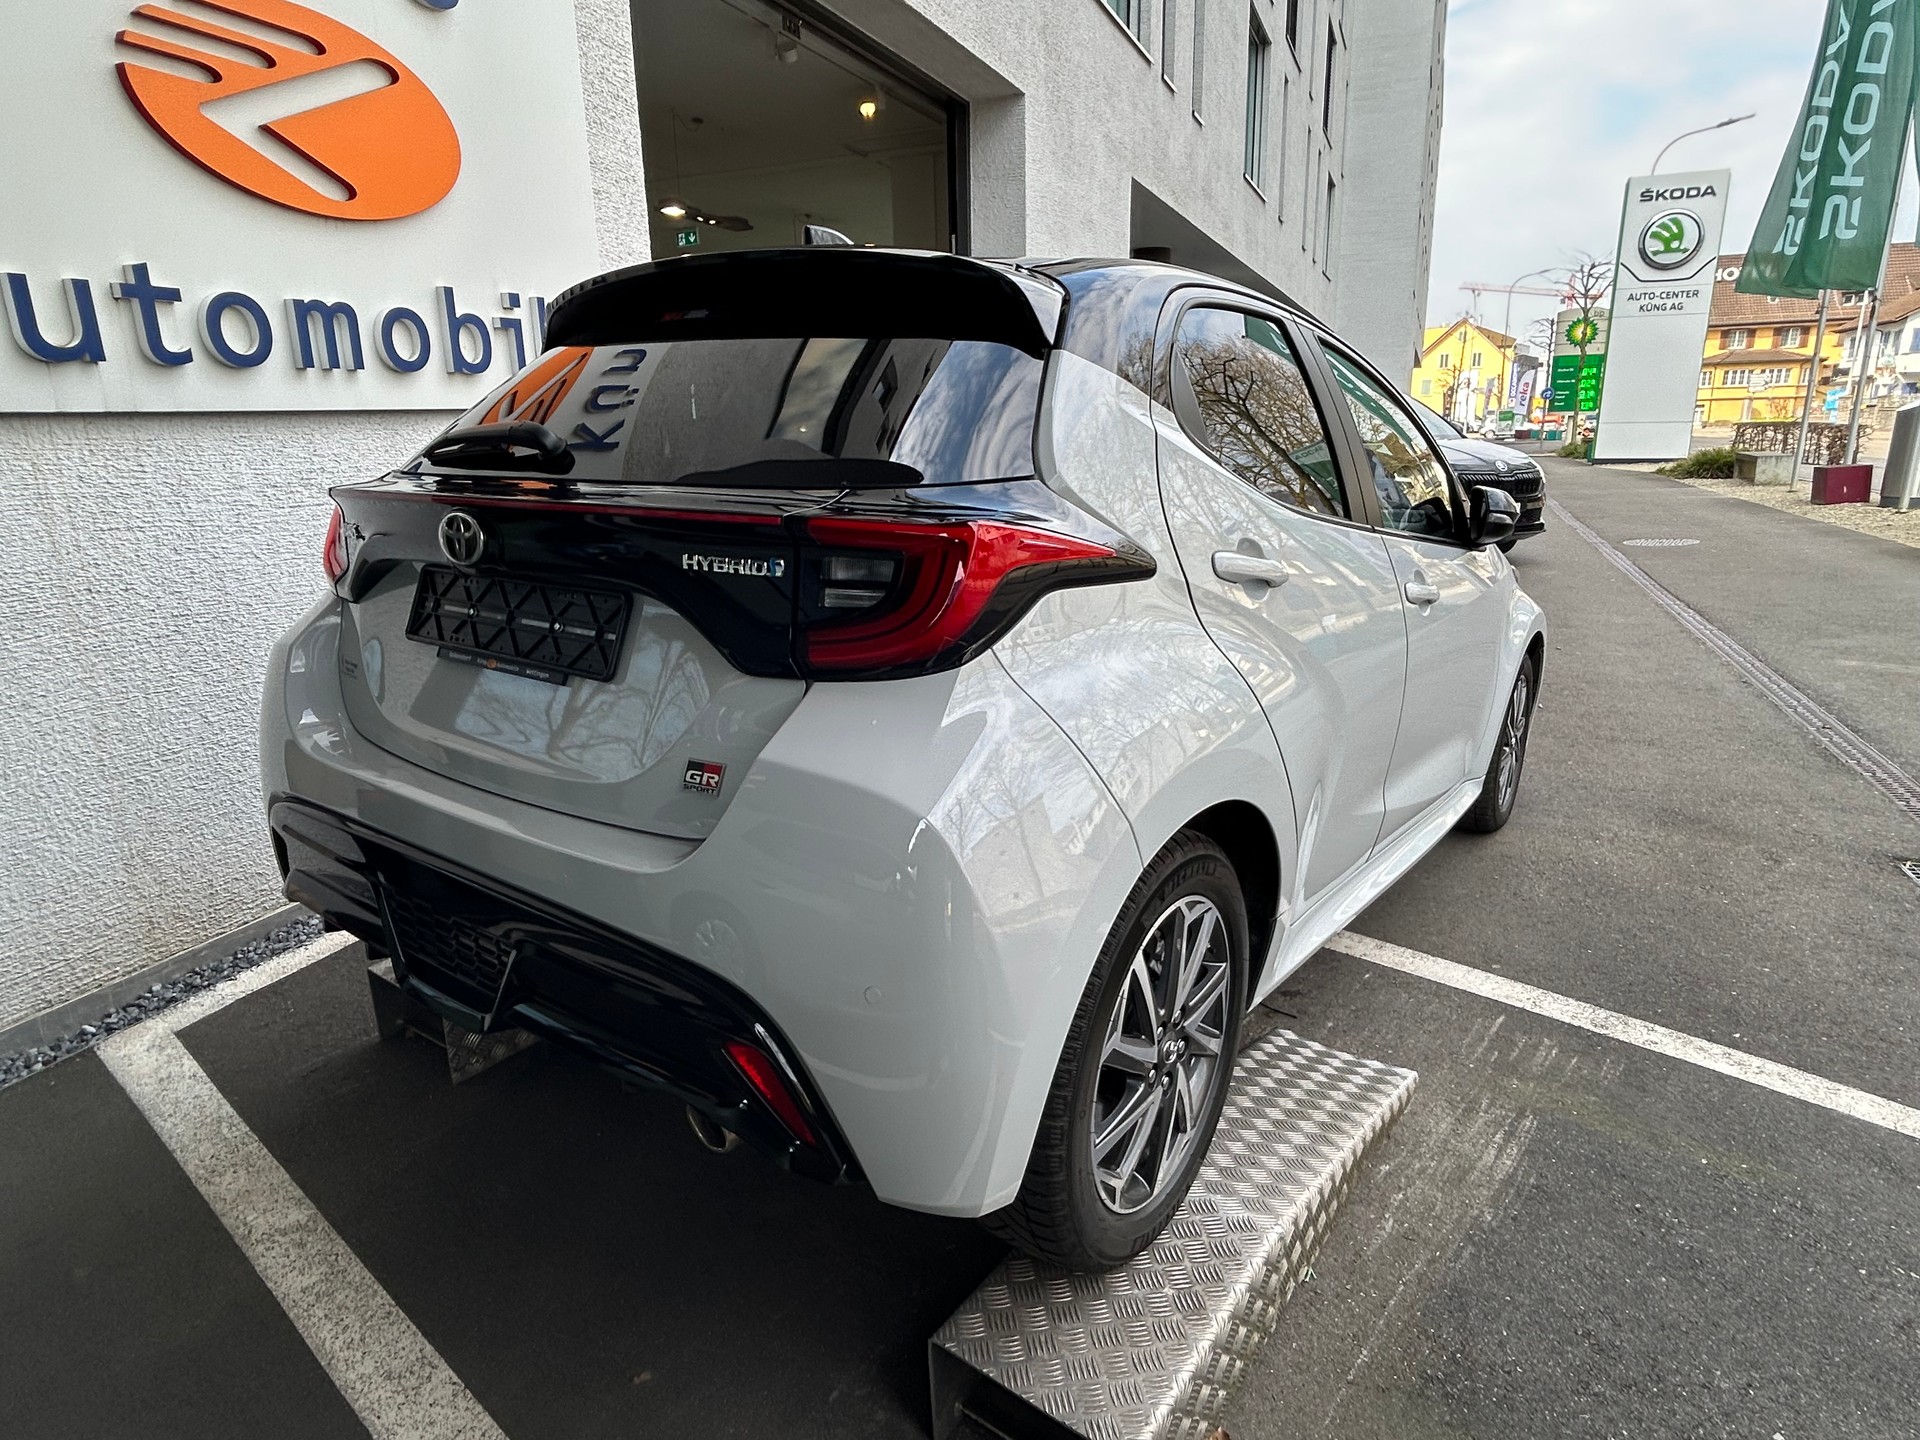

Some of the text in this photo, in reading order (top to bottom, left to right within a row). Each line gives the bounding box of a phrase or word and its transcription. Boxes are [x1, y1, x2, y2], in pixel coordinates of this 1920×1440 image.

[1627, 289, 1700, 302] AUTO-CENTER
[1638, 301, 1684, 313] KÜNG AG
[1519, 381, 1531, 407] reka
[682, 553, 768, 577] HYBRID
[685, 769, 720, 788] GR
[683, 783, 717, 794] SPORT
